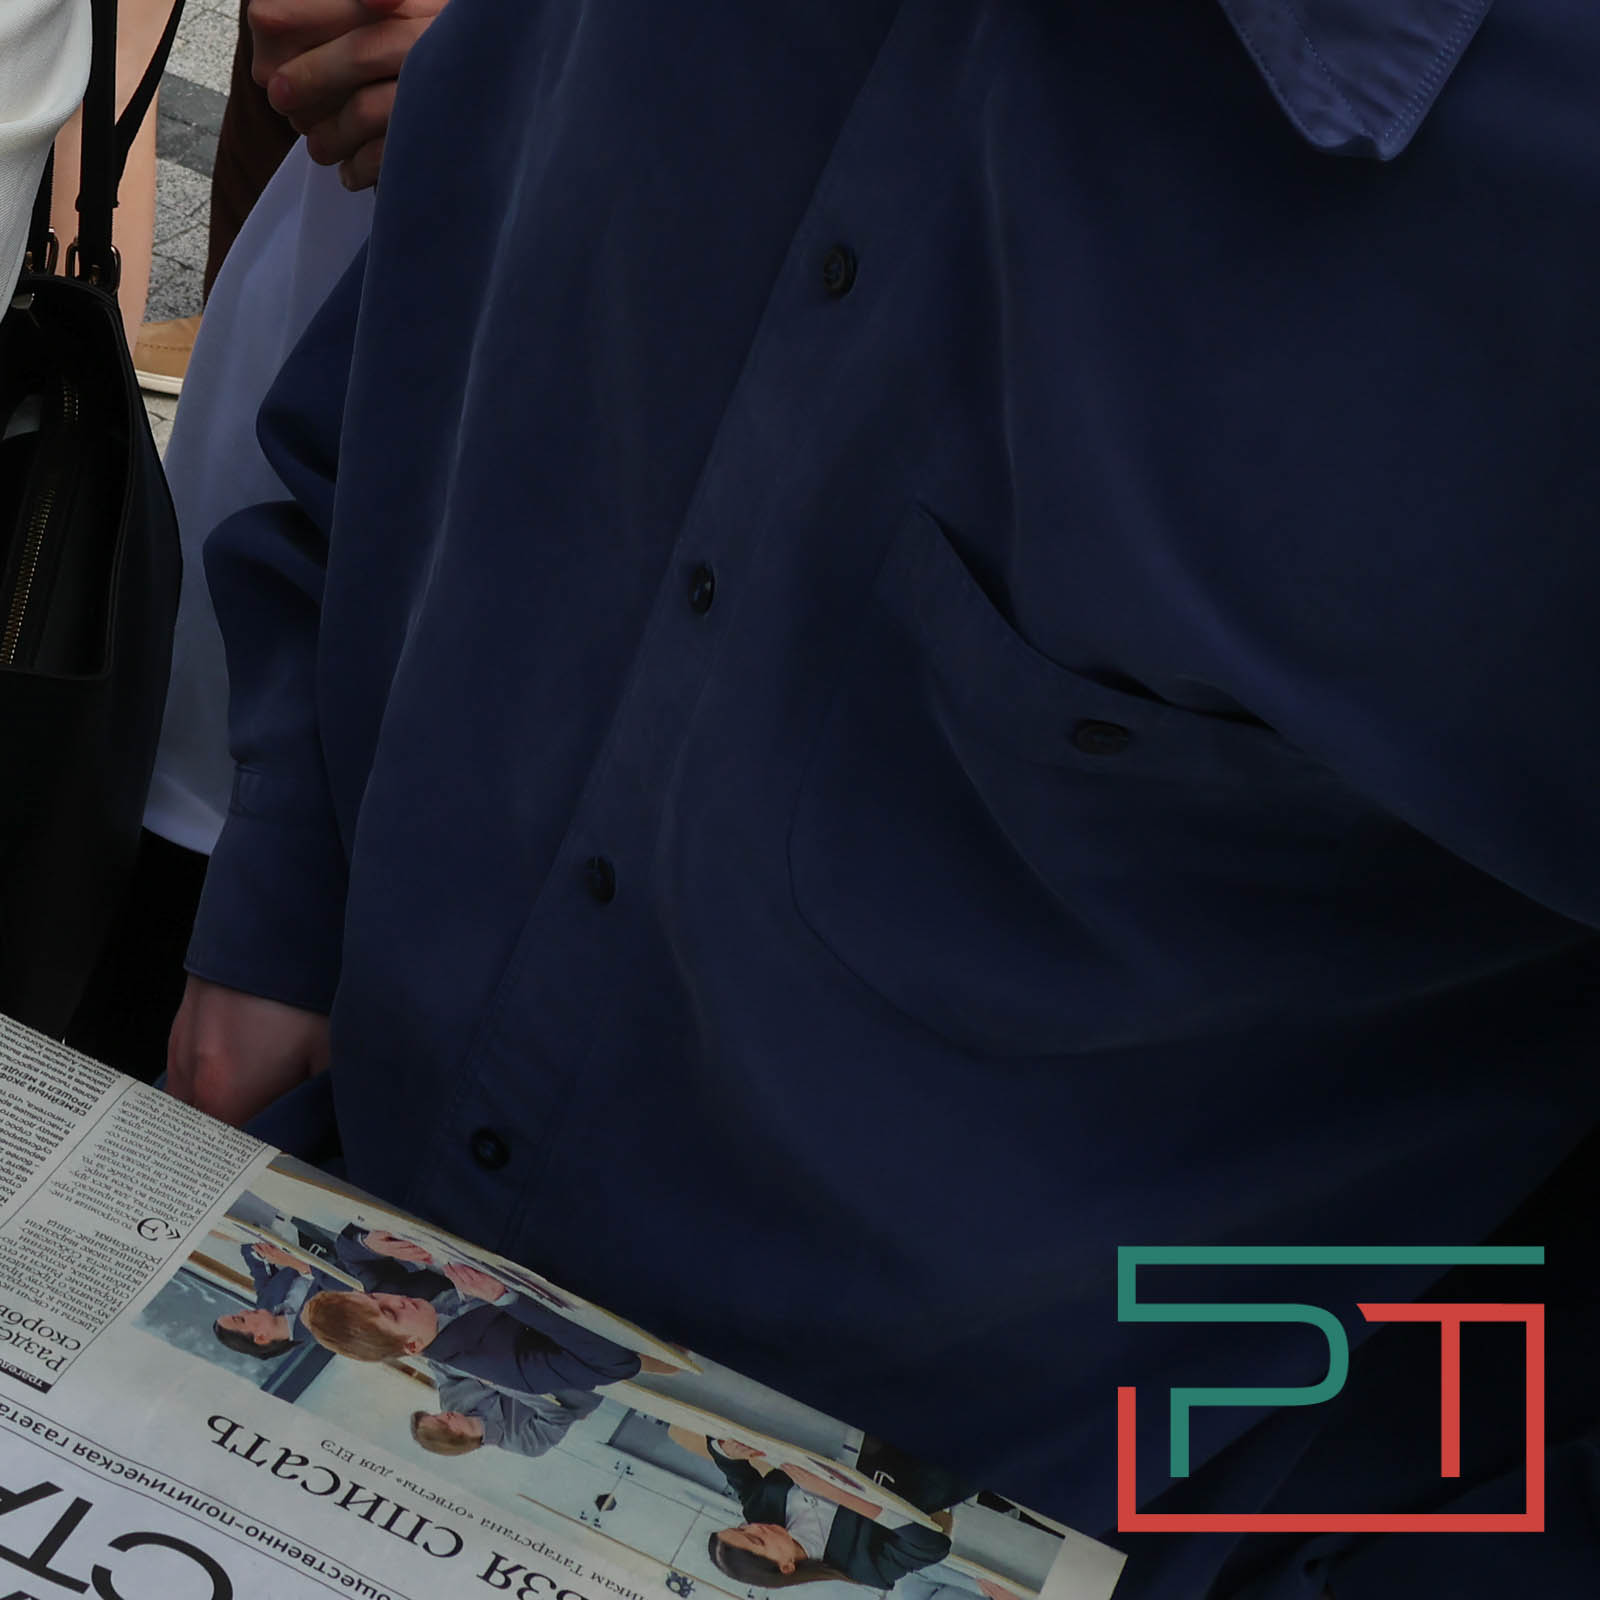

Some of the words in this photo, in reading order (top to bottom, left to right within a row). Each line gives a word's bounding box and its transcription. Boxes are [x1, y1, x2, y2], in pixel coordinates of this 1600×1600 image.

[321, 1440, 354, 1463] ЕГЭ
[359, 1458, 394, 1476] для
[207, 1415, 463, 1558] списать
[396, 1478, 474, 1519] «ответы»
[480, 1518, 582, 1576] Татарстана
